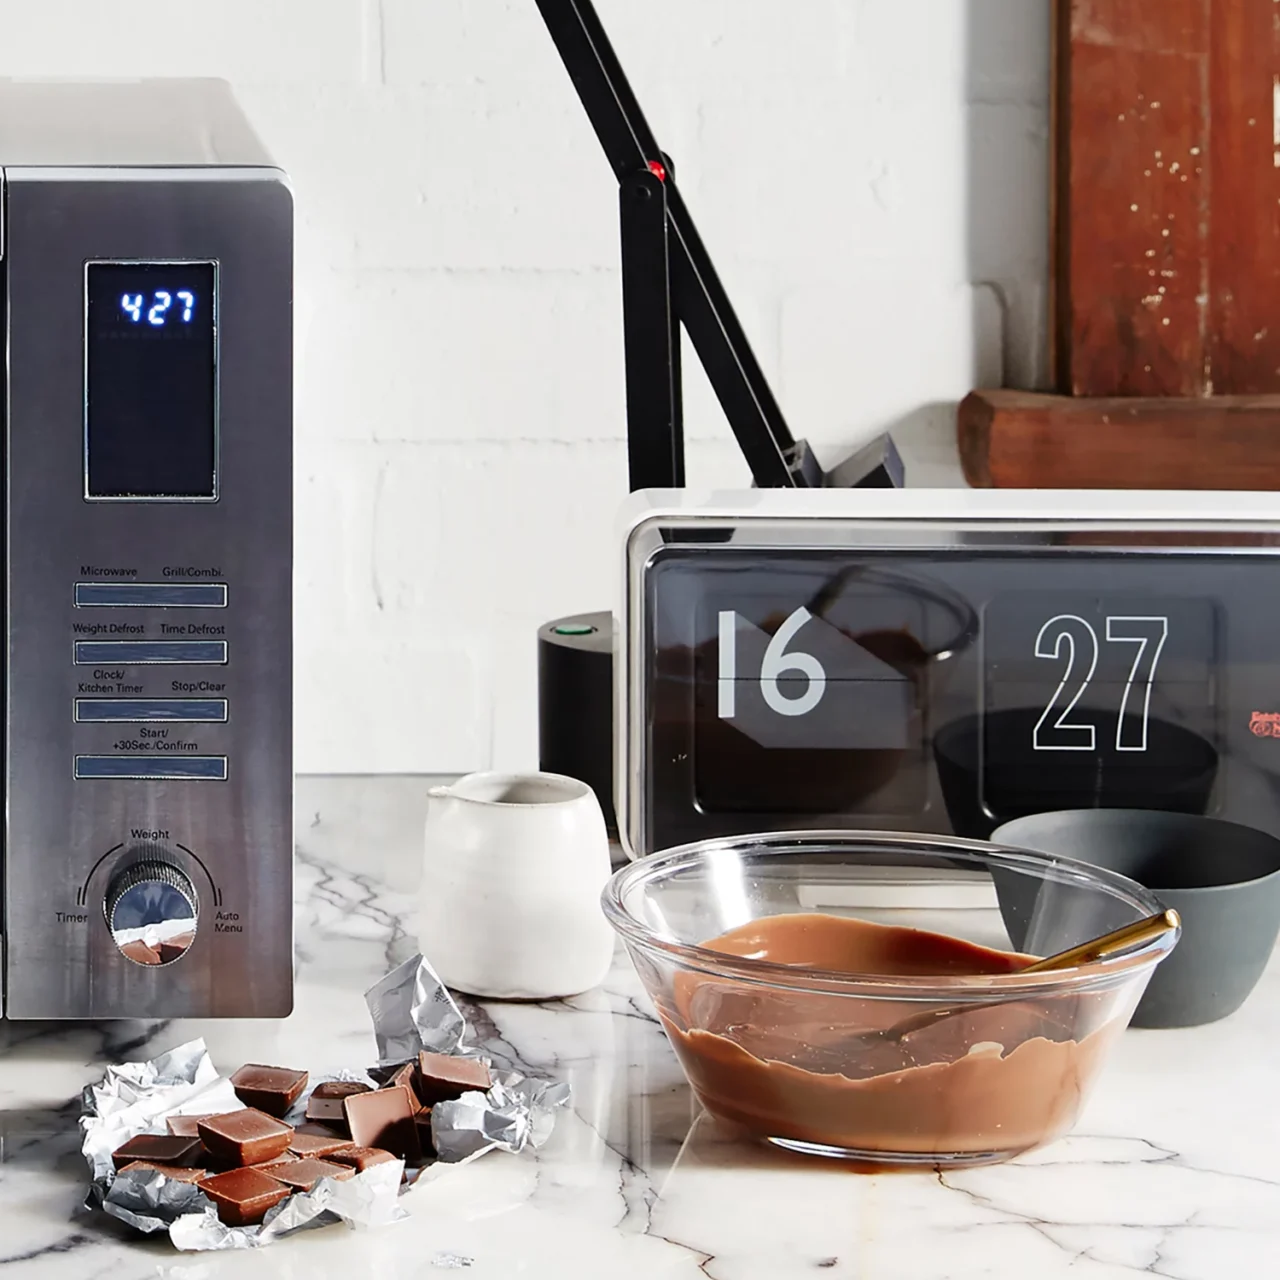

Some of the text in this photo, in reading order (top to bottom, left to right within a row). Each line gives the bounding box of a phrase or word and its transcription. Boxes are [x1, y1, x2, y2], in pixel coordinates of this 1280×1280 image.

[120, 291, 195, 325] 427
[80, 566, 137, 577] Microwave
[162, 566, 224, 578] Grill/Combi.
[73, 623, 144, 634] Weight Defrost
[161, 623, 225, 634] Time Defrost
[717, 606, 827, 718] 16
[93, 669, 124, 680] Clock/
[78, 683, 143, 693] Kitchen Timer
[172, 681, 226, 693] Stop/Clear
[1032, 614, 1169, 752] 27
[140, 728, 169, 738] Start/
[131, 829, 170, 841] Weight
[56, 912, 88, 923] Timer
[215, 911, 239, 921] Auto
[214, 923, 243, 933] Menu
